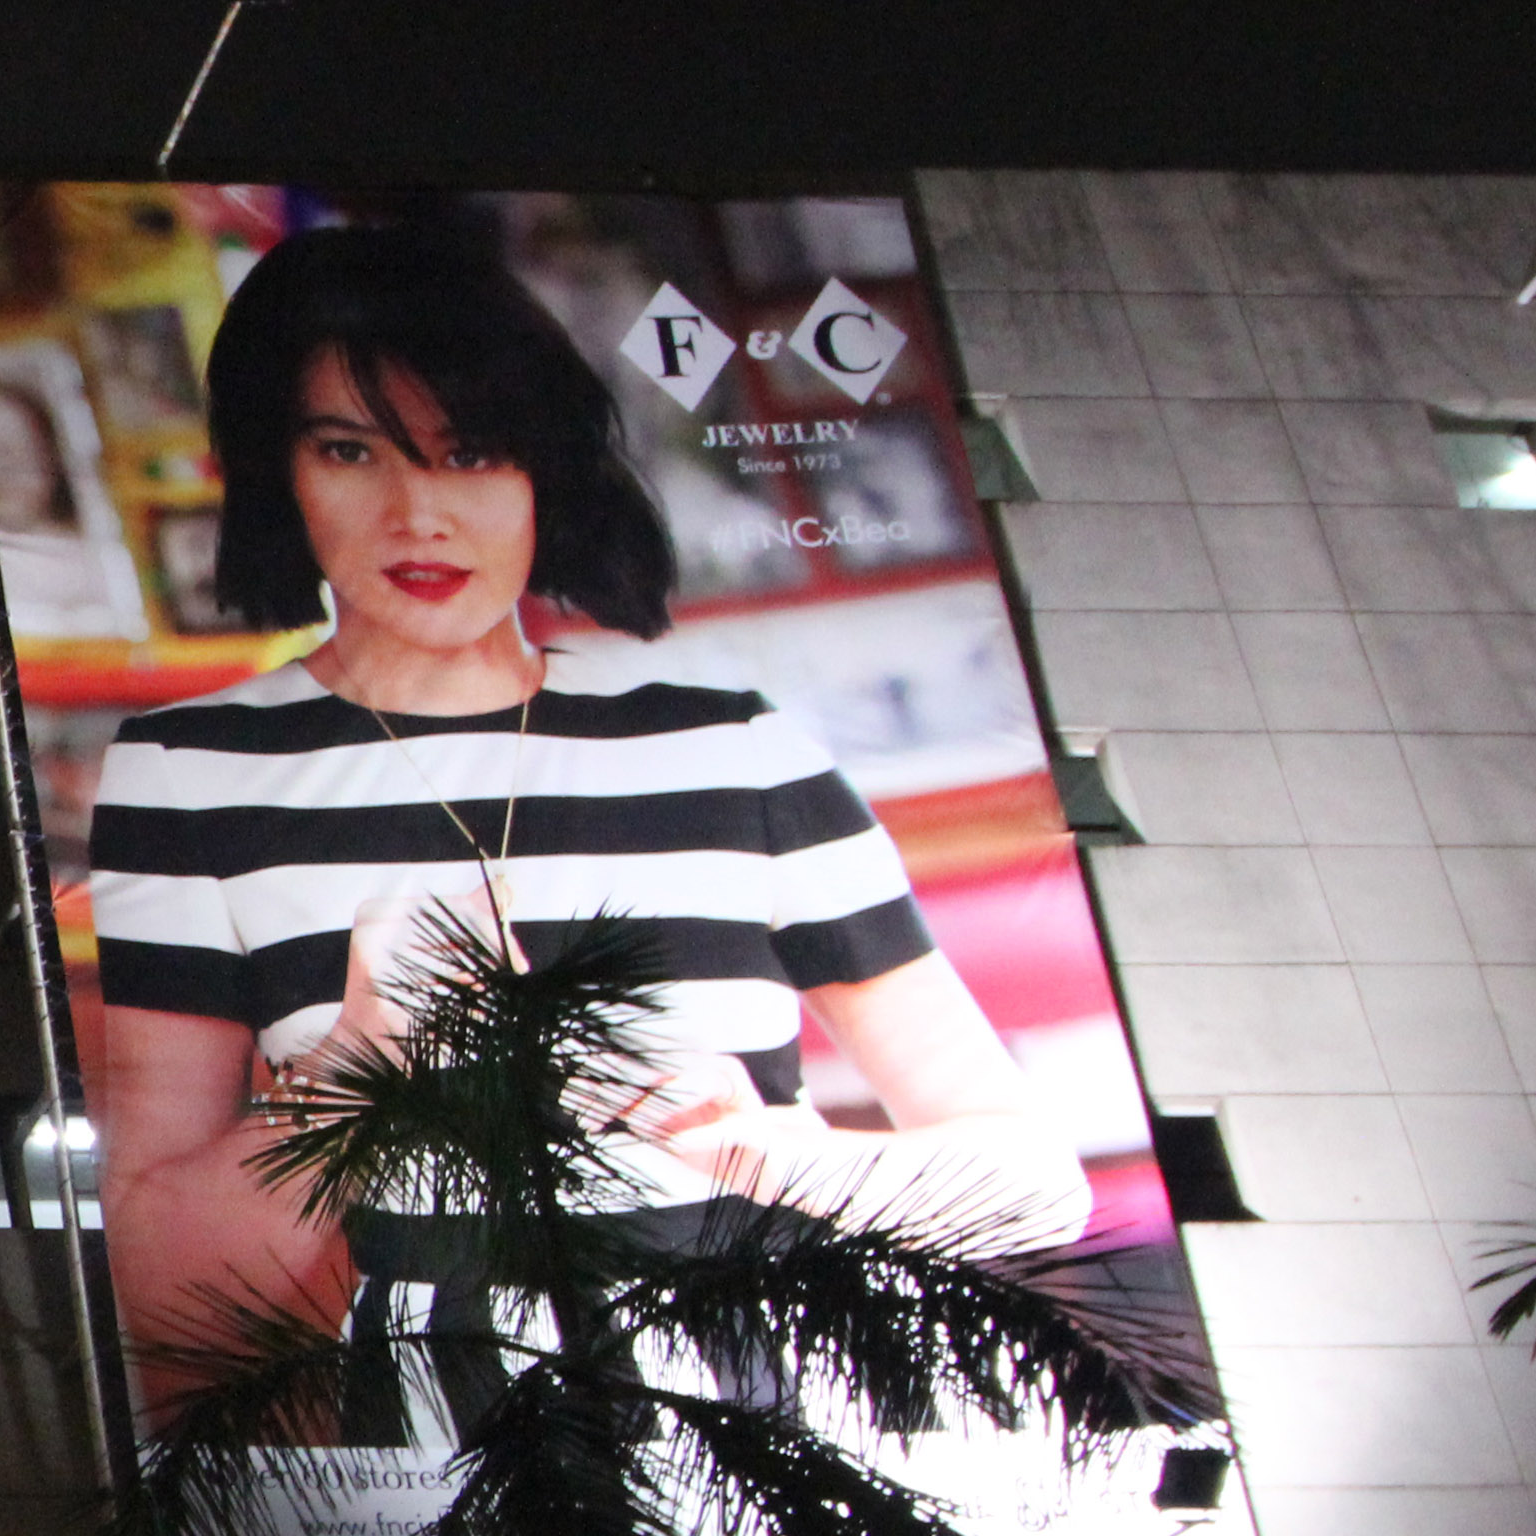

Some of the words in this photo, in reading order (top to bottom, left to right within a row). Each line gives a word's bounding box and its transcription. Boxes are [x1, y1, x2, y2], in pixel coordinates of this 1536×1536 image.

[649, 316, 703, 378] F
[747, 331, 781, 359] &
[814, 313, 882, 374] C
[701, 417, 860, 449] JEWELRY
[737, 456, 787, 474] Since
[710, 514, 912, 553] #FNCxBea
[355, 1461, 453, 1490] stores
